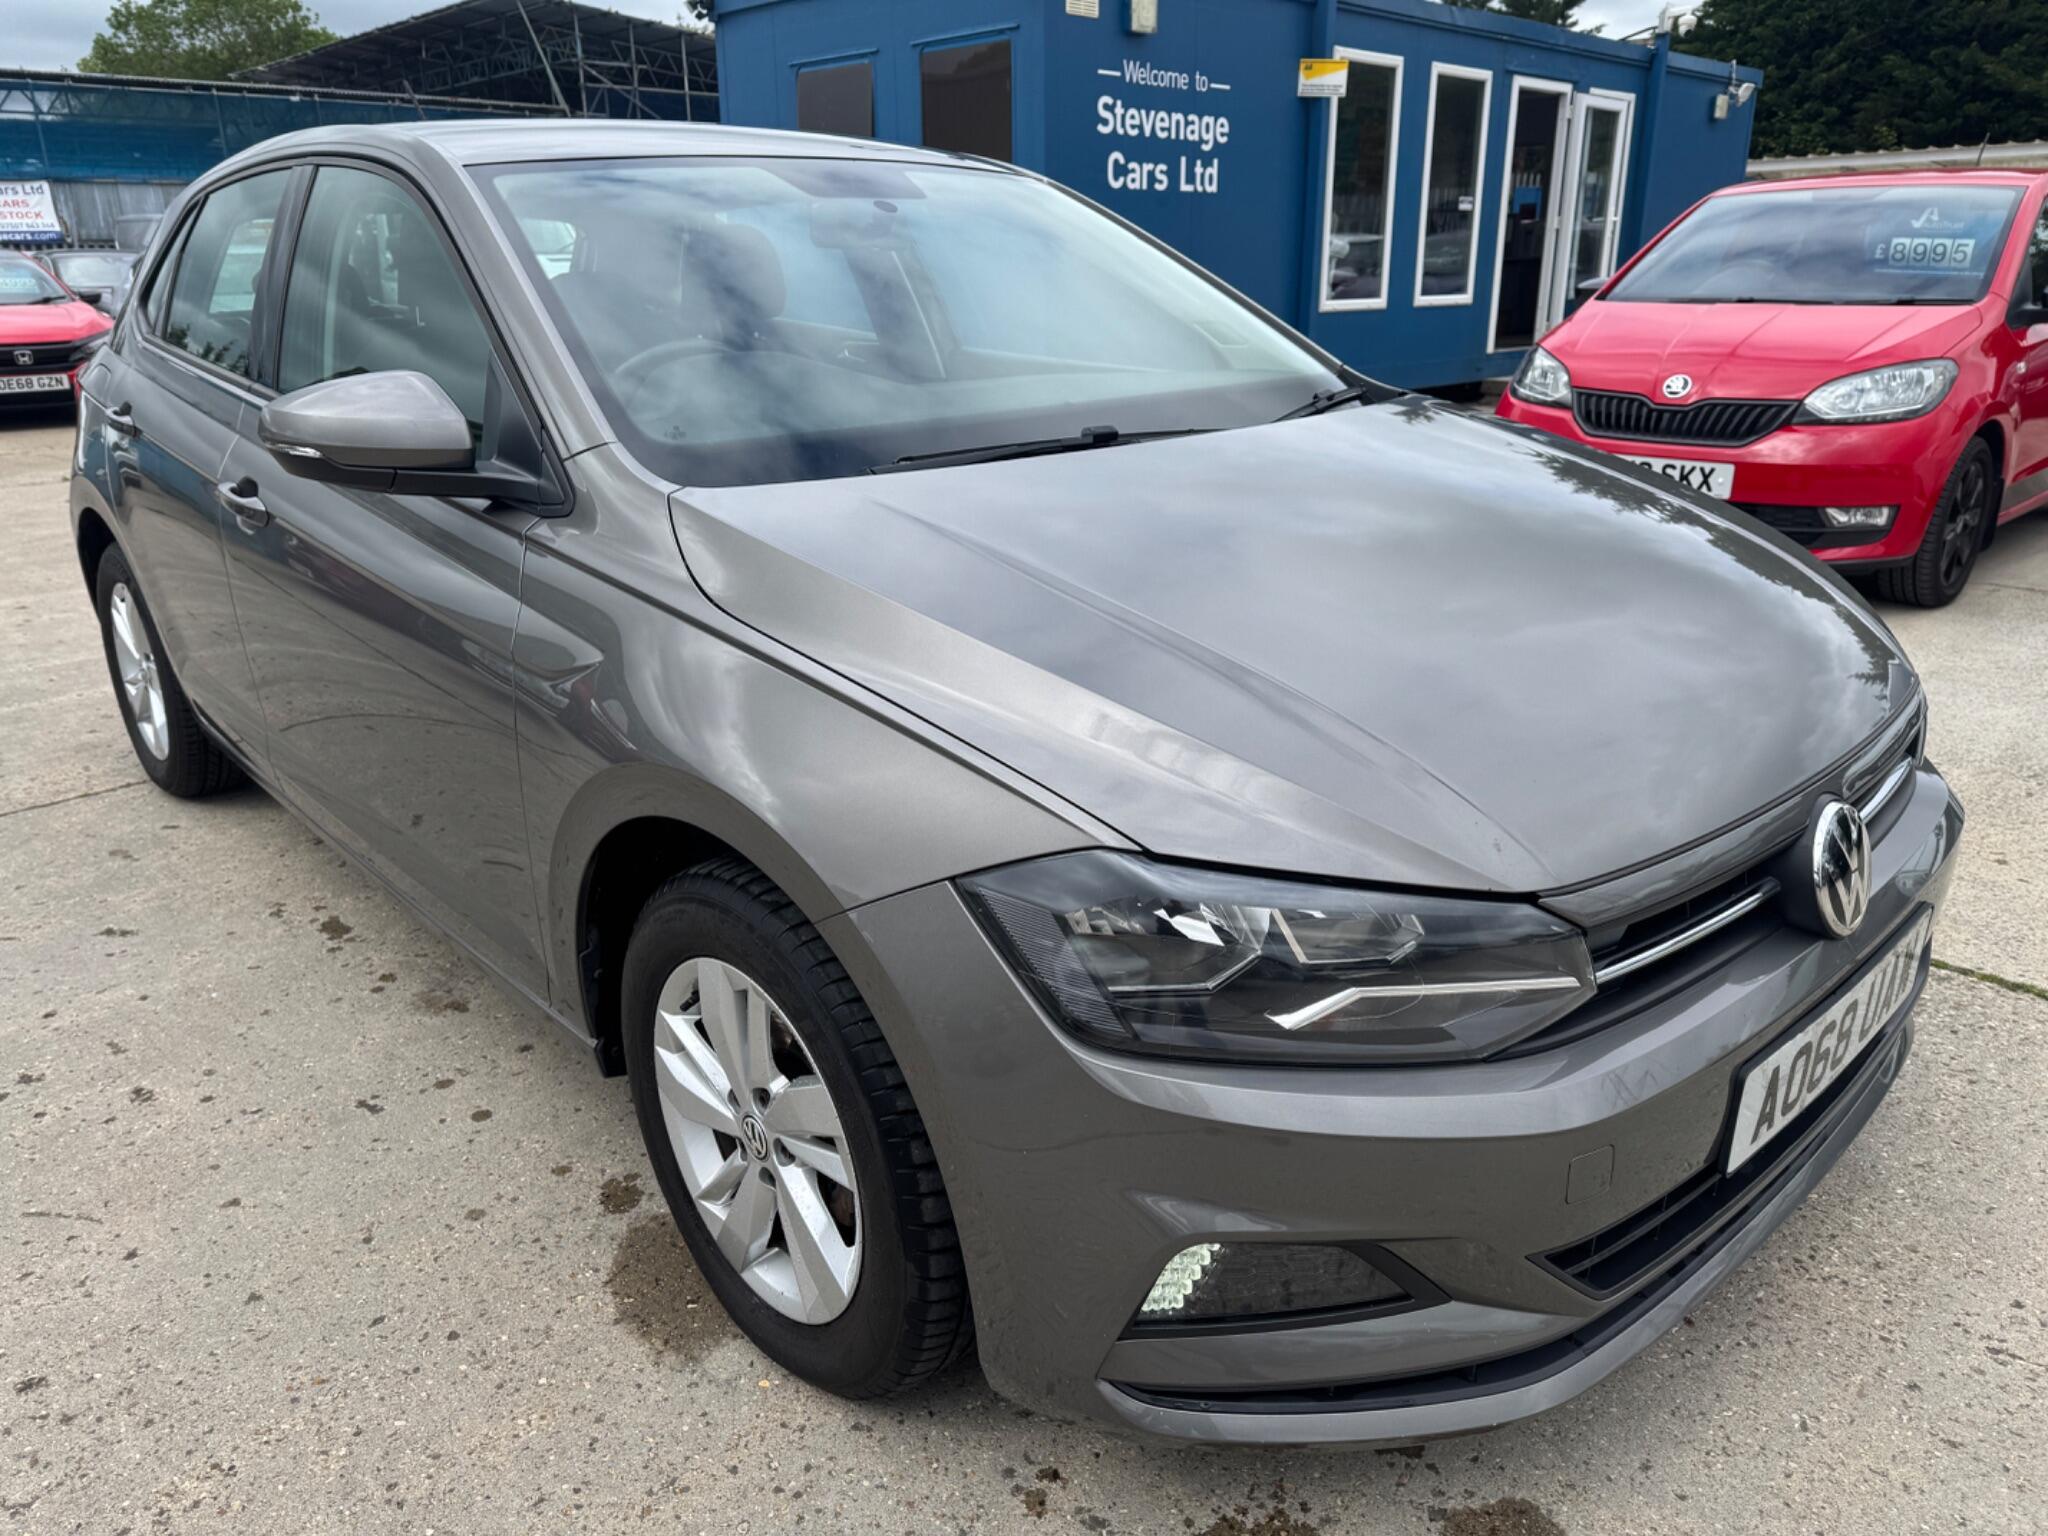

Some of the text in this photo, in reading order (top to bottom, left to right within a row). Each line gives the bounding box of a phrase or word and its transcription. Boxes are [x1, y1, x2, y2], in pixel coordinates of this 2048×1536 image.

[1122, 59, 1208, 92] Welcome to
[1096, 95, 1230, 151] Stevenage
[1107, 151, 1219, 193] Cars Ltd
[21, 183, 44, 195] Ltd
[0, 199, 30, 208] ARS
[0, 211, 44, 219] STOCK
[36, 376, 64, 388] GZN
[1661, 463, 1716, 492] SKX
